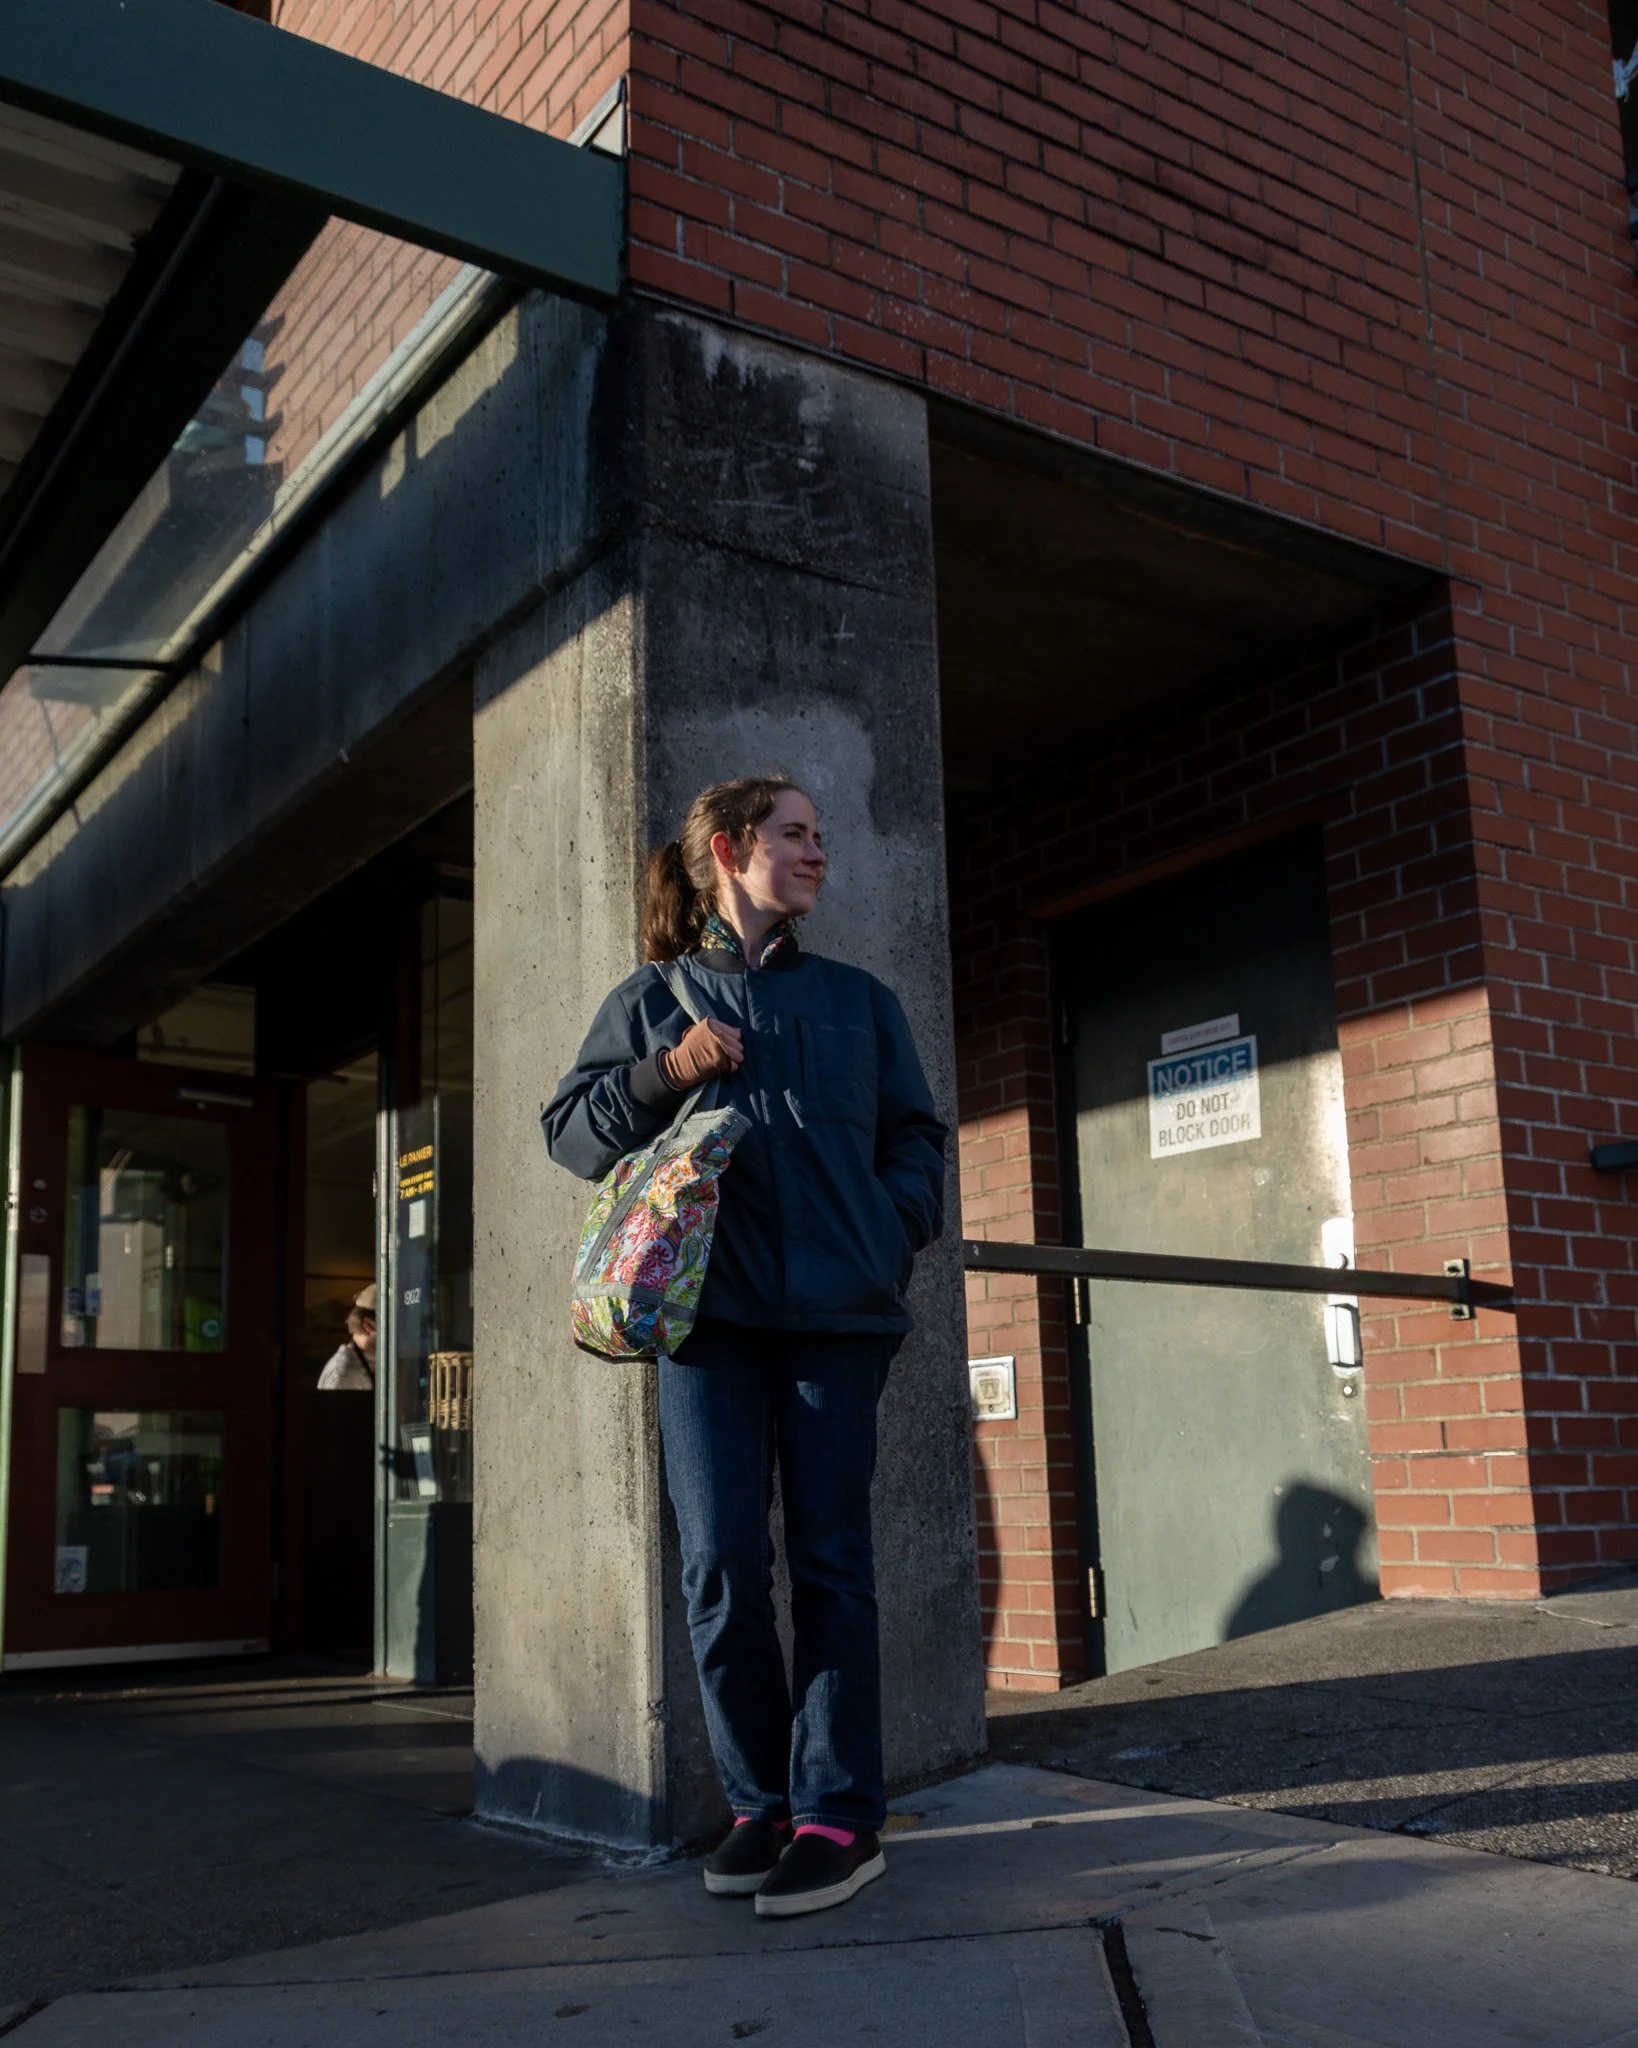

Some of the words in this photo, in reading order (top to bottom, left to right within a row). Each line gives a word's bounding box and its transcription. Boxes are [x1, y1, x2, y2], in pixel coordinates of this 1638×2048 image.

[1157, 1050, 1247, 1095] NOTICE
[1177, 1100, 1196, 1120] DO
[1201, 1092, 1230, 1115] NOT
[1159, 1121, 1205, 1147] BLOCK
[1210, 1112, 1251, 1137] DOOR
[399, 1154, 408, 1168] LE
[408, 1145, 434, 1165] PANIER
